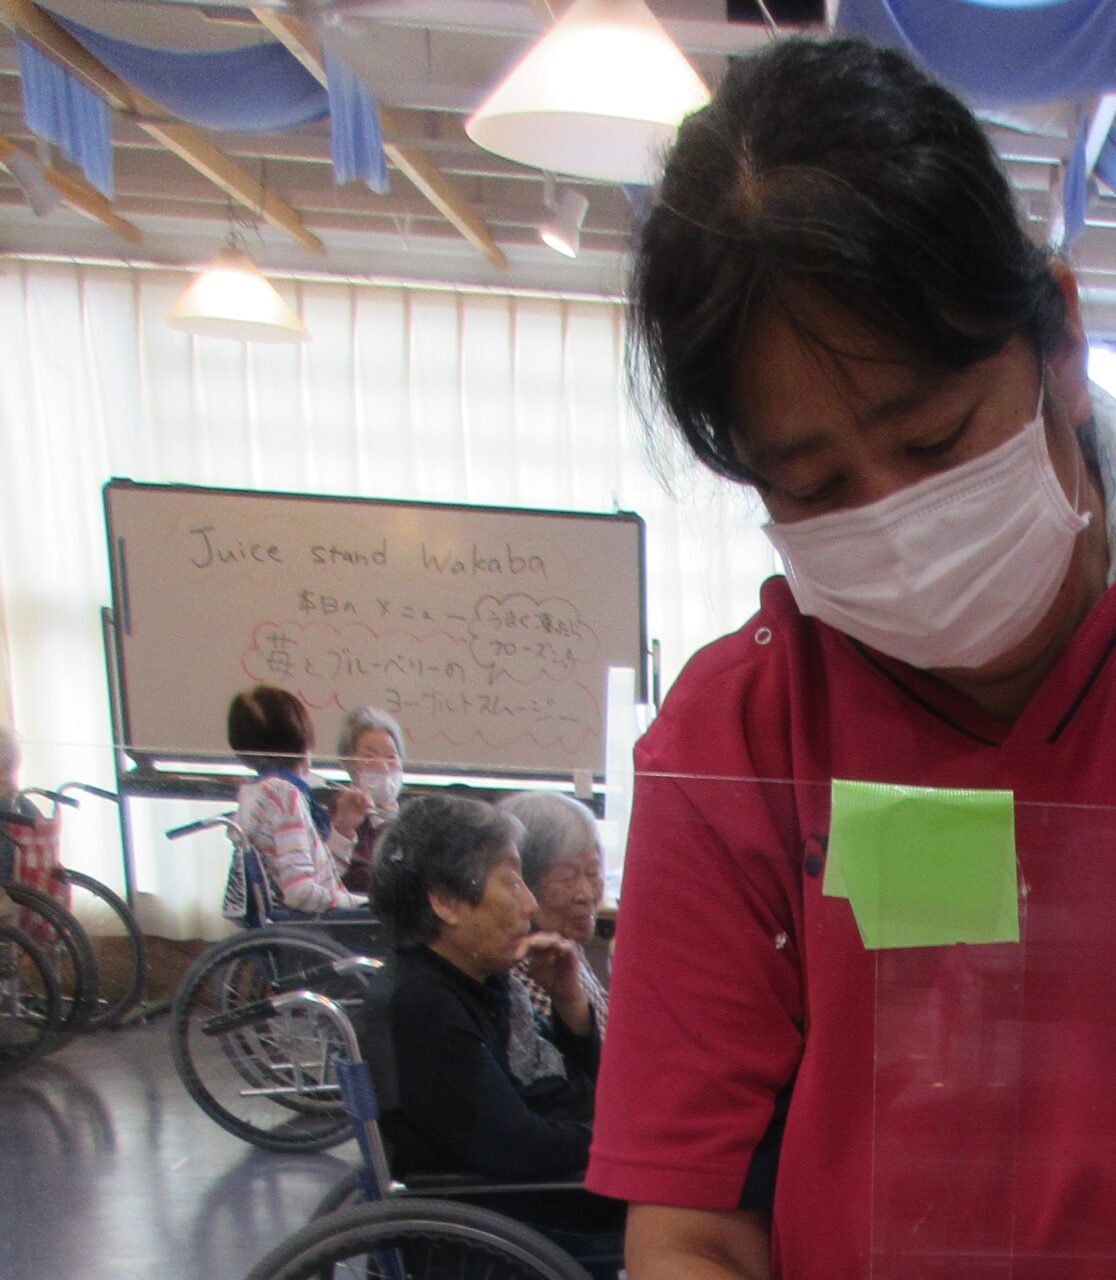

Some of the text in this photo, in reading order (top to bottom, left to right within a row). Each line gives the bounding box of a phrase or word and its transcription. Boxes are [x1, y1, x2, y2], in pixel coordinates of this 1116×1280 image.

[189, 526, 549, 579] Juice stand Wakaba
